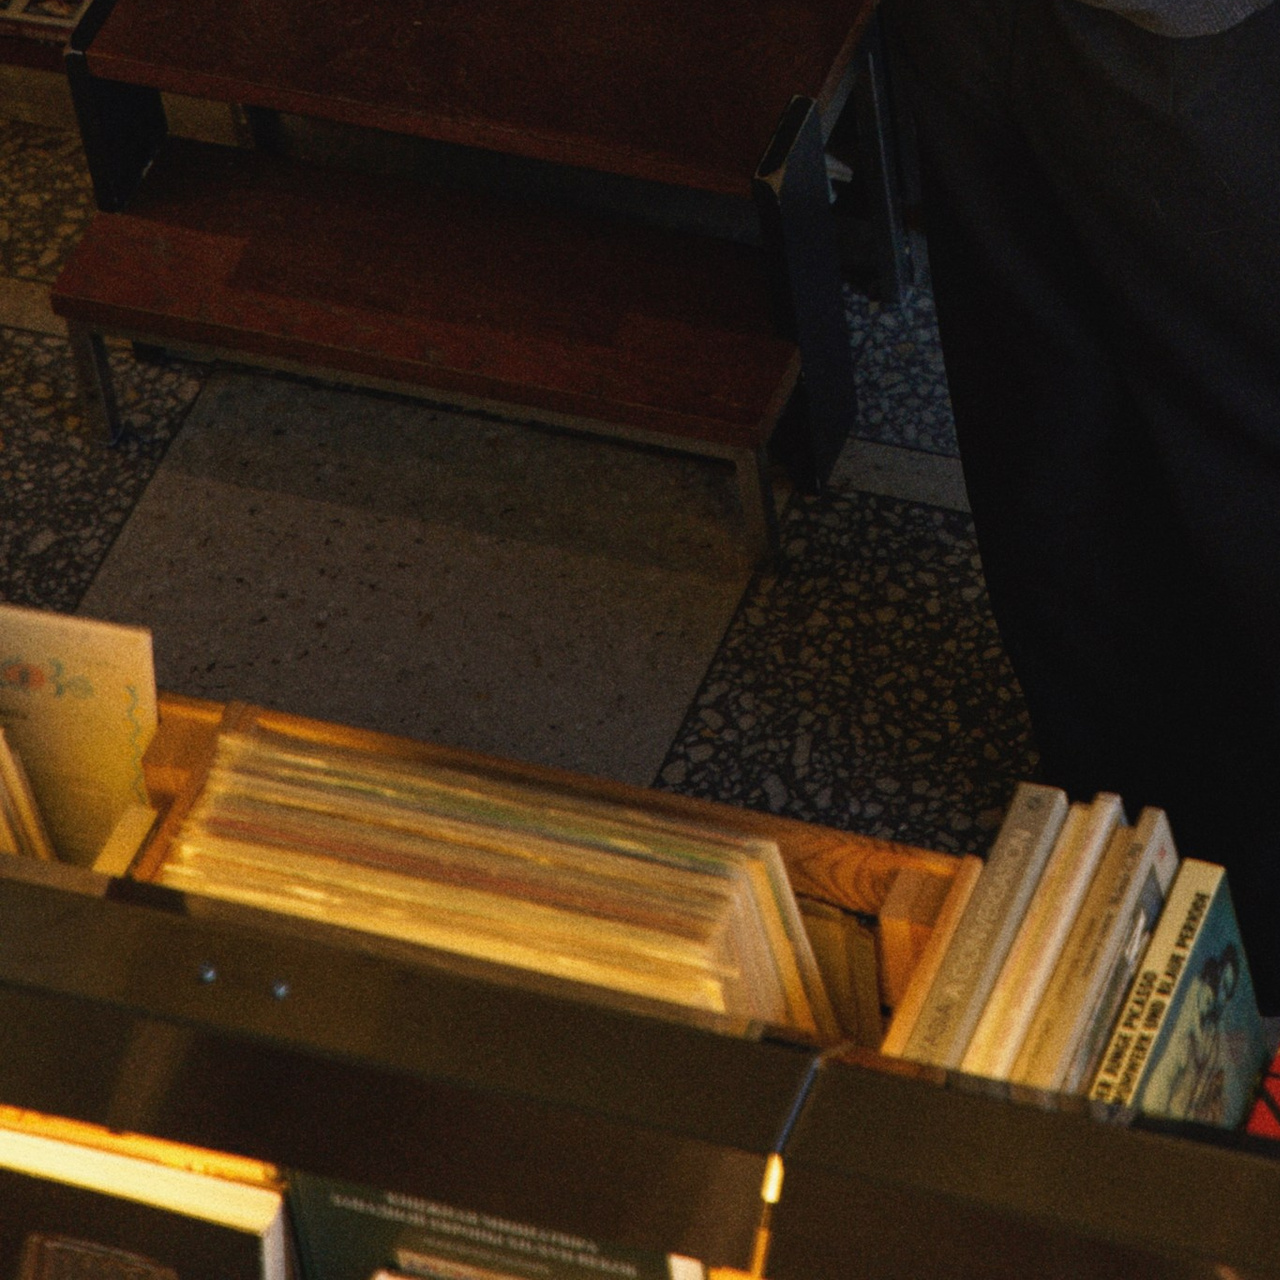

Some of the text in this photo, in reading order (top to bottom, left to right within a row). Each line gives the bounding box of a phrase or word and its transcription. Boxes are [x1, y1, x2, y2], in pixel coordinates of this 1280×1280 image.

[1172, 888, 1212, 951] PERIODE
[1100, 967, 1161, 1078] JUNGE PICASSO
